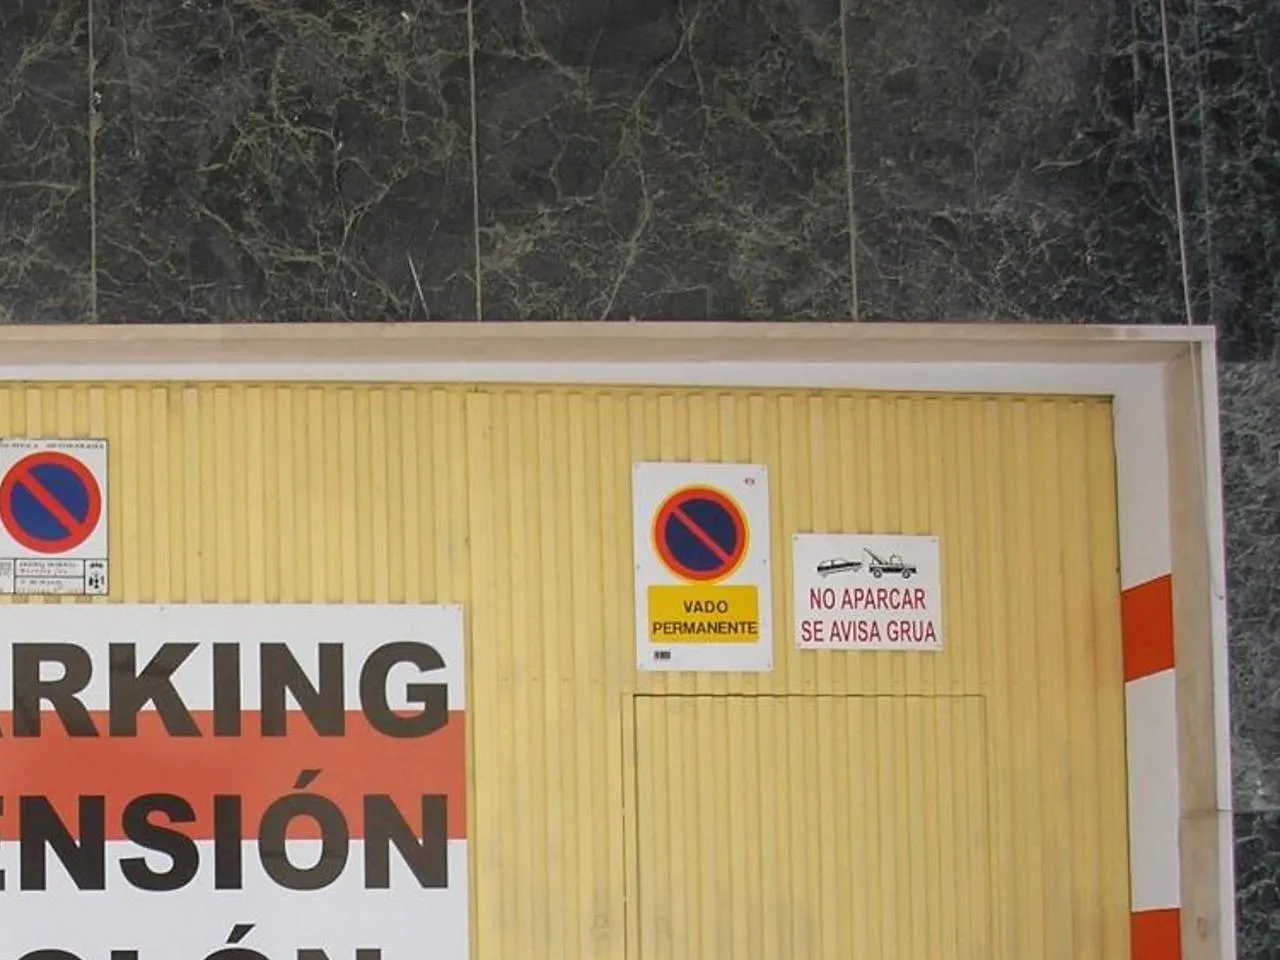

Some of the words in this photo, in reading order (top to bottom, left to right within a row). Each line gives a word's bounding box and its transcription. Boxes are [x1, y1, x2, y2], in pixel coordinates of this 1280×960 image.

[683, 600, 729, 614] VADO
[809, 587, 835, 610] NO
[841, 588, 926, 610] APARCAR
[652, 621, 758, 635] PERMANENTE
[801, 620, 823, 642] SE
[829, 620, 881, 642] AVISA
[886, 620, 937, 642] GRUA
